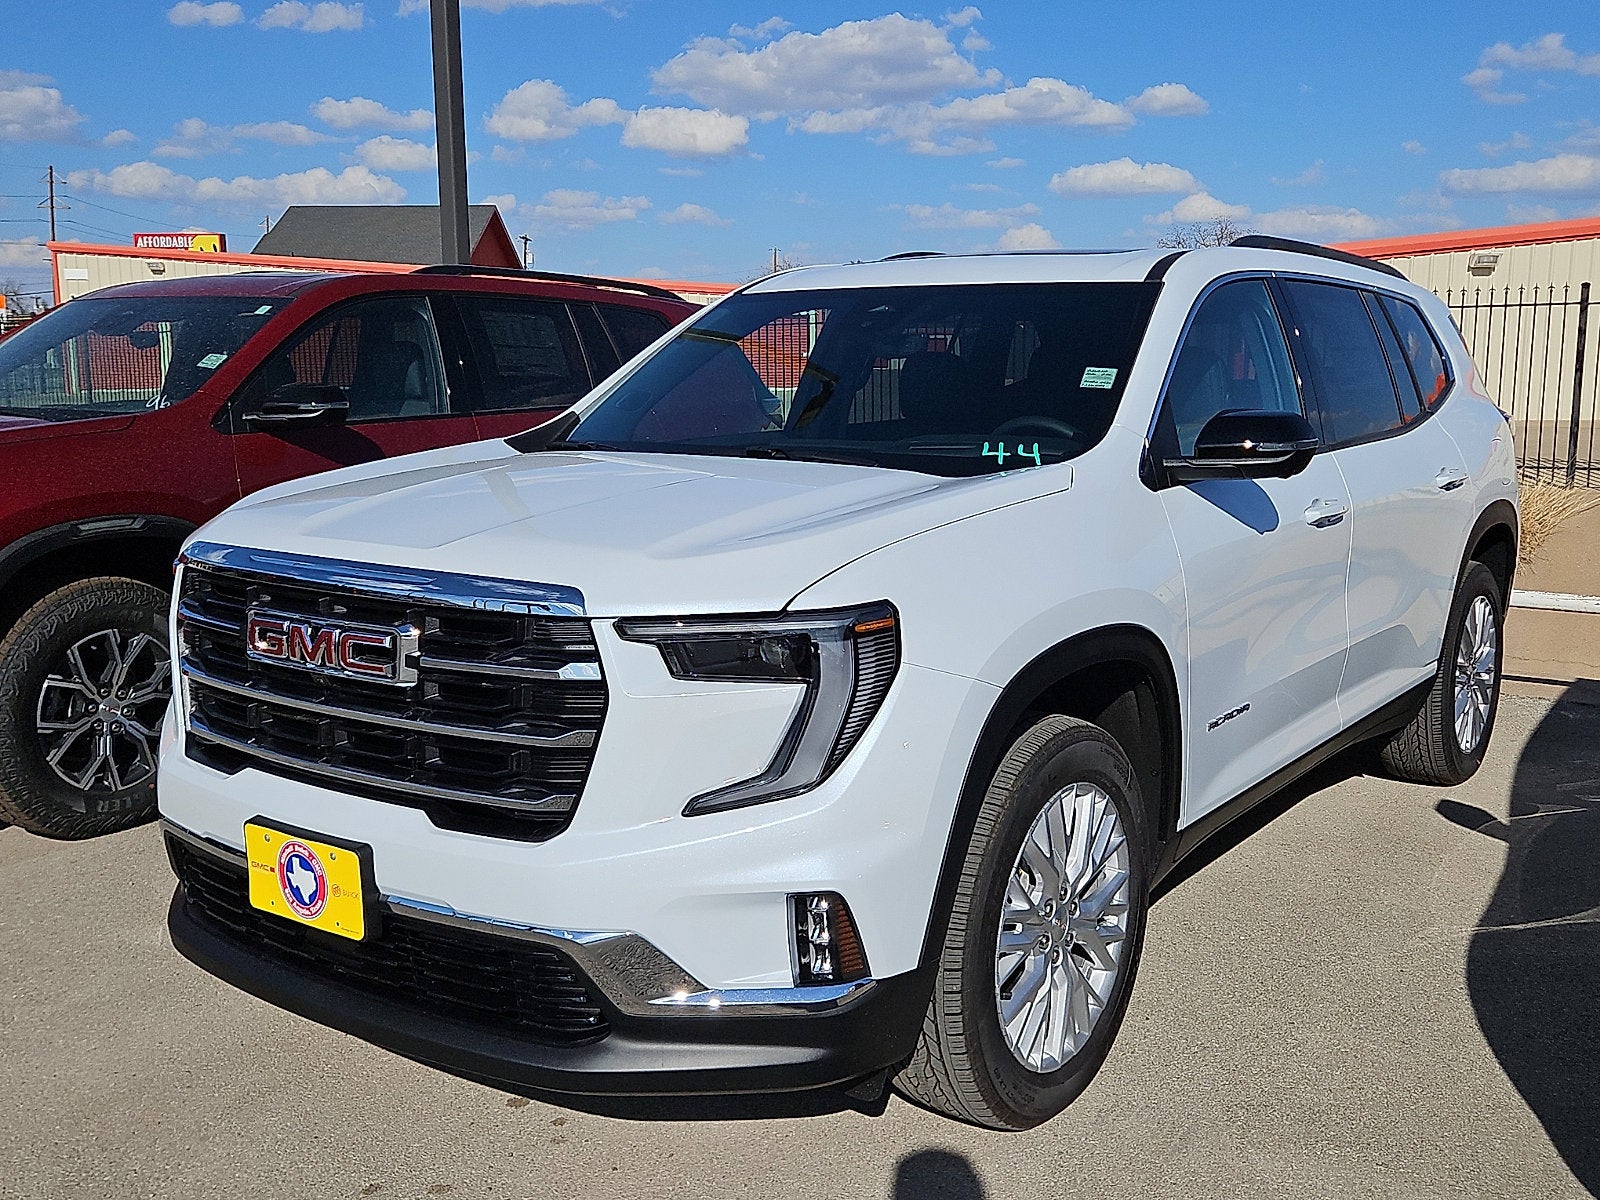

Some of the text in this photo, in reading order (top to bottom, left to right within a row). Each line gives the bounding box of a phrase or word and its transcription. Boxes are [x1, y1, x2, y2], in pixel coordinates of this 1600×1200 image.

[137, 236, 193, 248] AFFORDABLE
[982, 441, 1041, 466] 44
[248, 616, 393, 678] GMC
[251, 860, 270, 872] GMC
